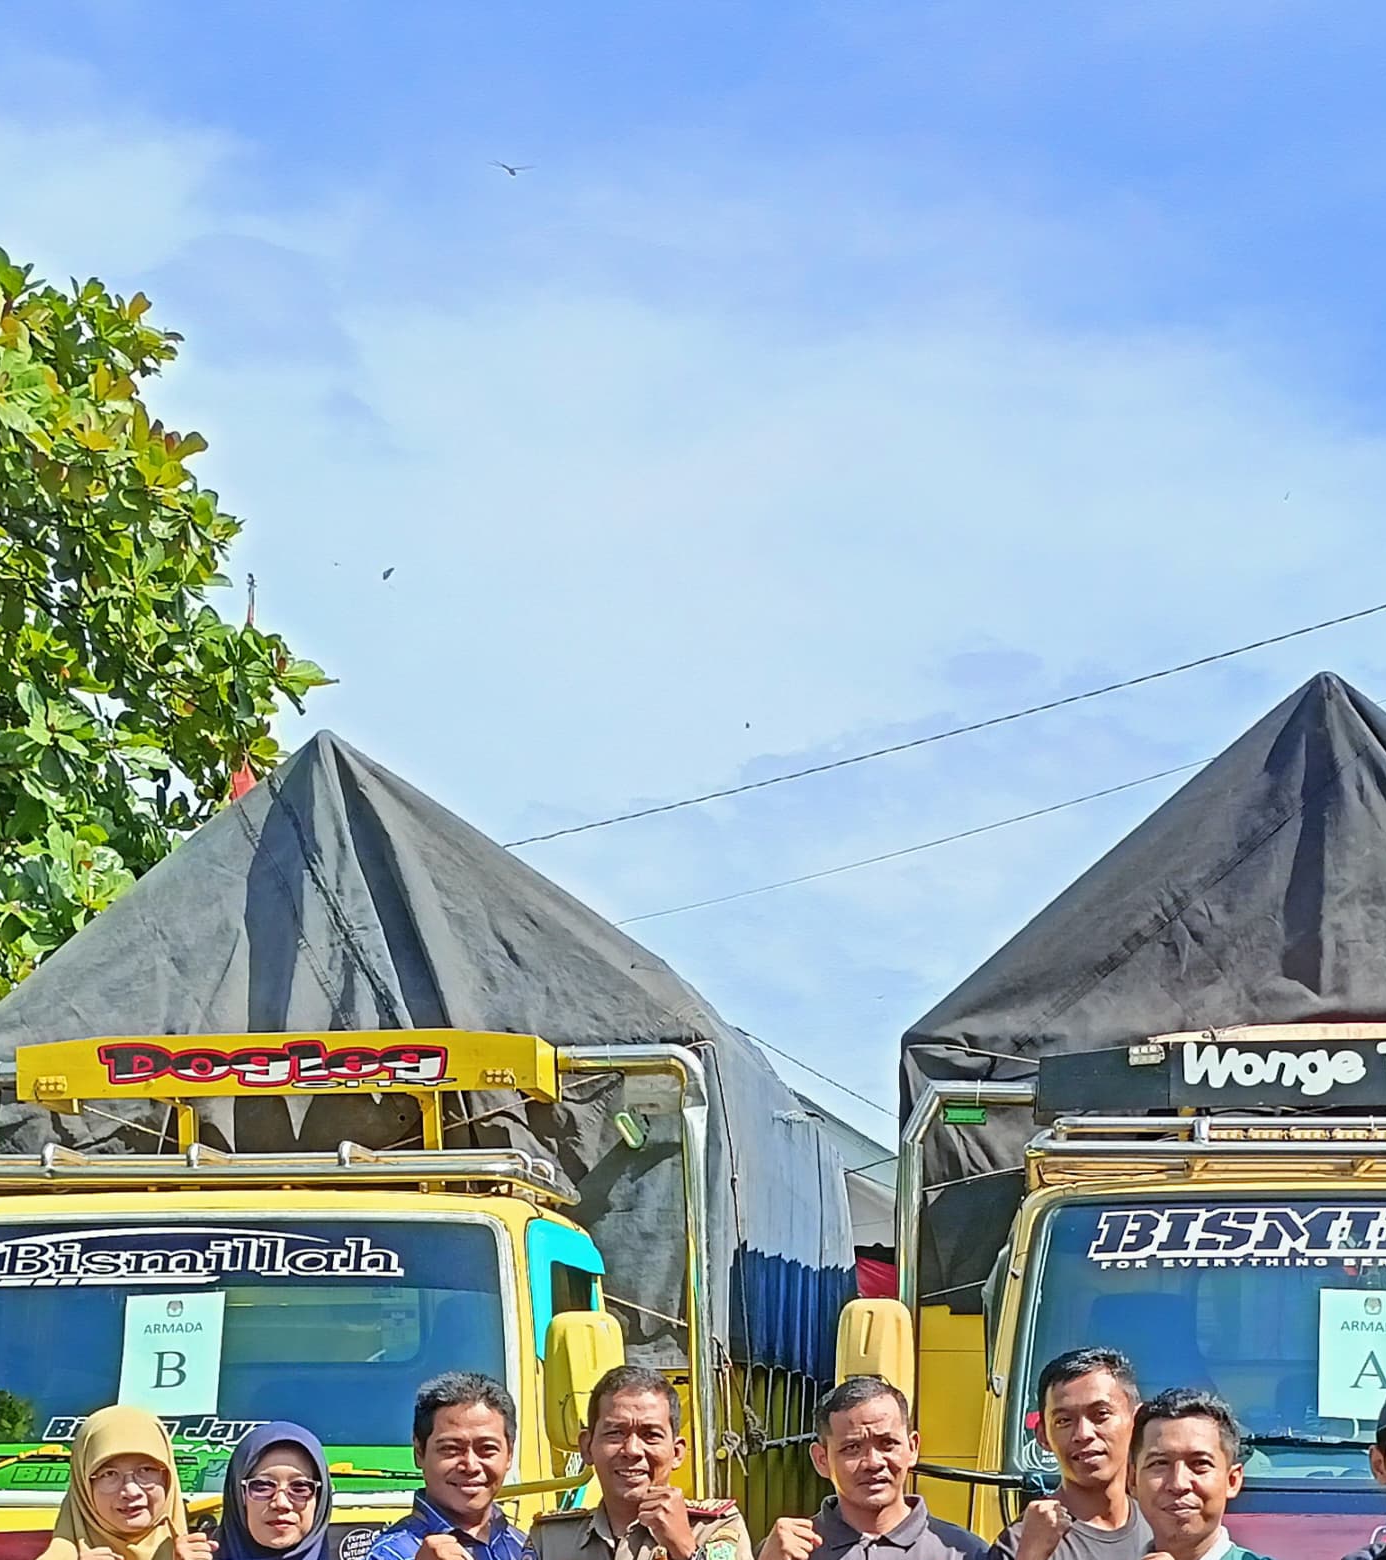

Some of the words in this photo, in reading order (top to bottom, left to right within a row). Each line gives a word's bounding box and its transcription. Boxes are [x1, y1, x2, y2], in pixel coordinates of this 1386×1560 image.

[98, 1040, 448, 1087] Dogleg
[1183, 1042, 1366, 1096] Wonge
[1100, 1259, 1148, 1270] FOR
[1163, 1257, 1329, 1268] EVERYTHING
[143, 1321, 204, 1335] ARMADA
[152, 1351, 188, 1390] B
